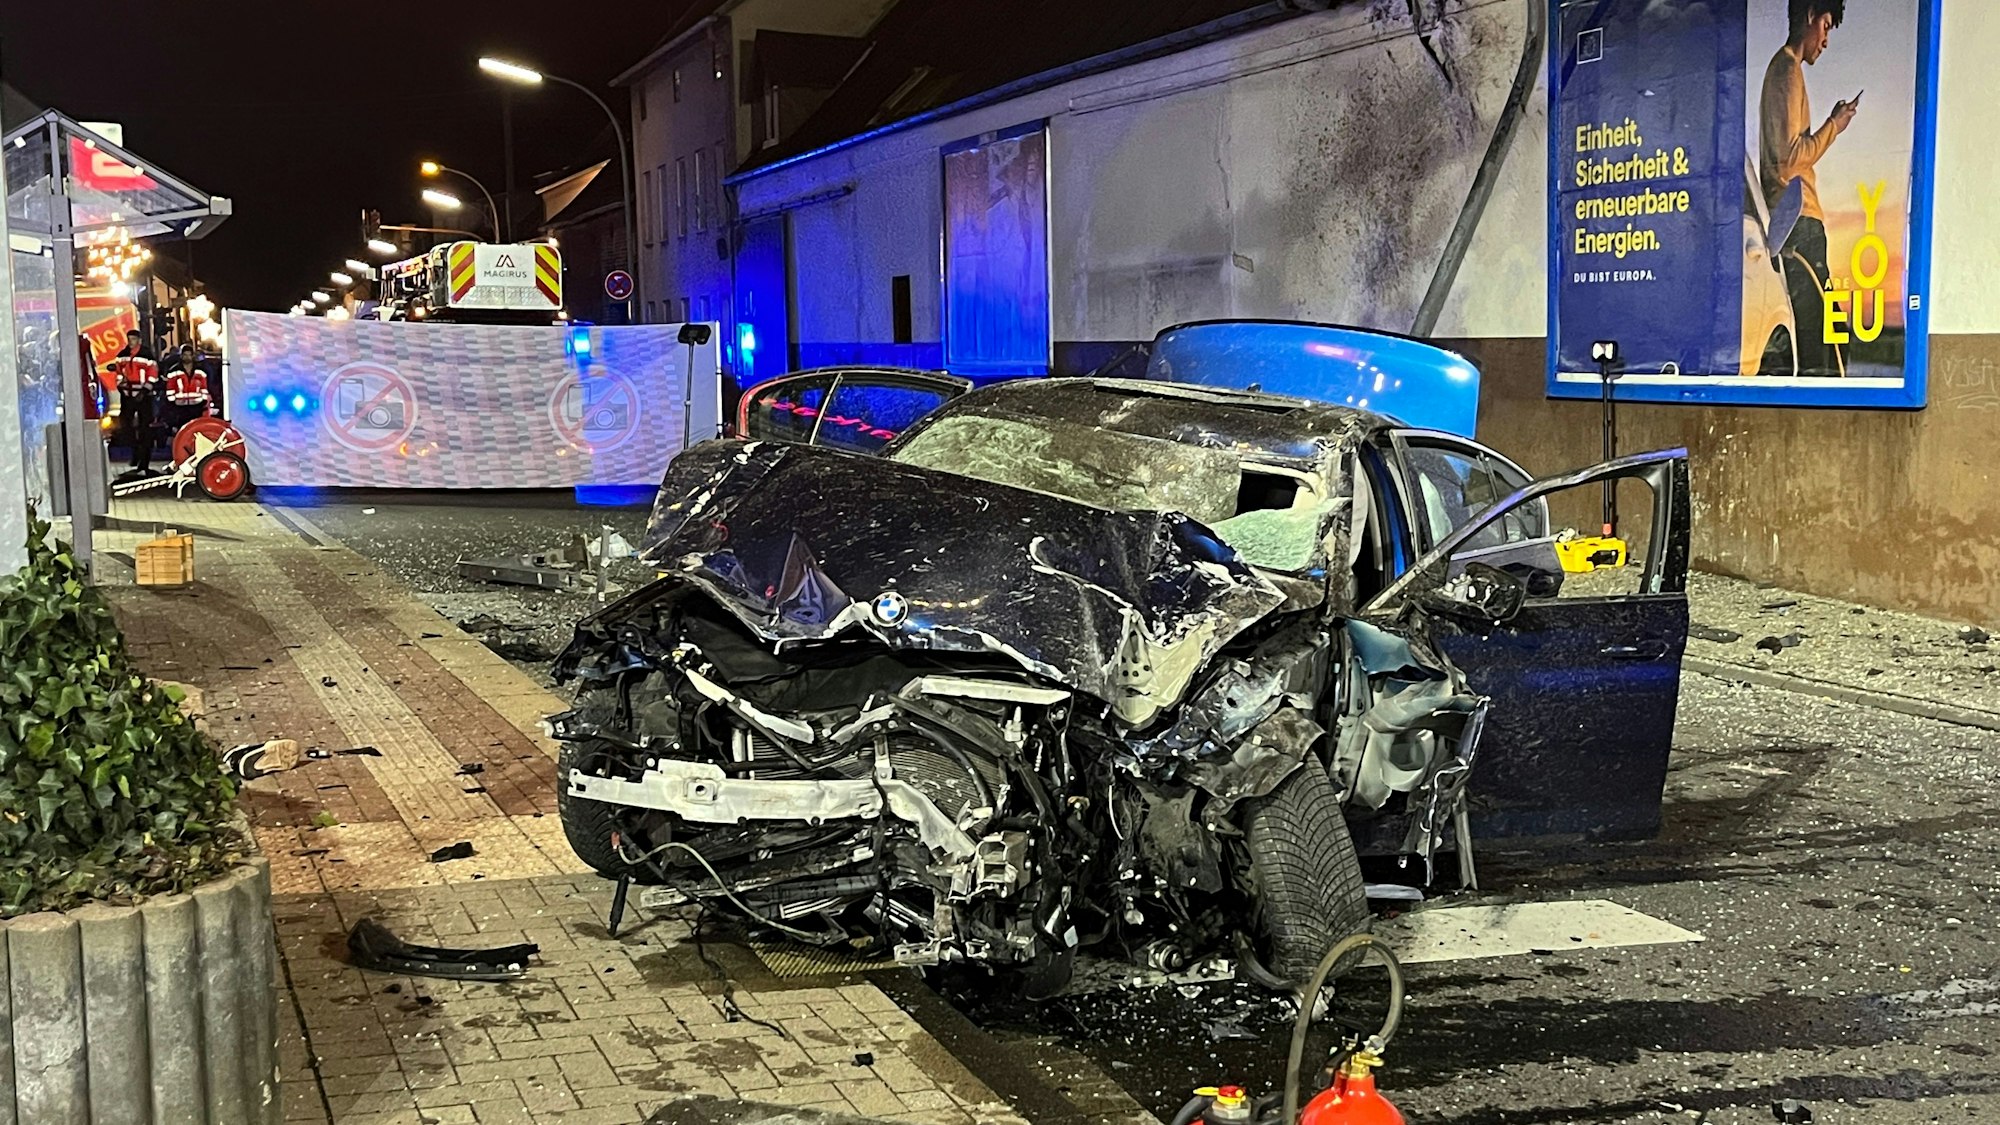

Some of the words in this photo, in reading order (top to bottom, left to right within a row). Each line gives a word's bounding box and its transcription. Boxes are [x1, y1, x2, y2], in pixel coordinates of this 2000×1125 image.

[1576, 117, 1643, 152] Einheit,
[1576, 149, 1669, 187] Sicherheit
[1673, 147, 1689, 176] &
[1575, 187, 1690, 220] erneuerbare
[1575, 223, 1660, 259] Energien.
[483, 270, 528, 279] MAGIRUS
[1573, 272, 1587, 283] DU
[1589, 271, 1611, 282] BIST
[1613, 269, 1657, 282] EUROPA.
[1824, 277, 1850, 291] ARE
[1823, 289, 1885, 344] EU
